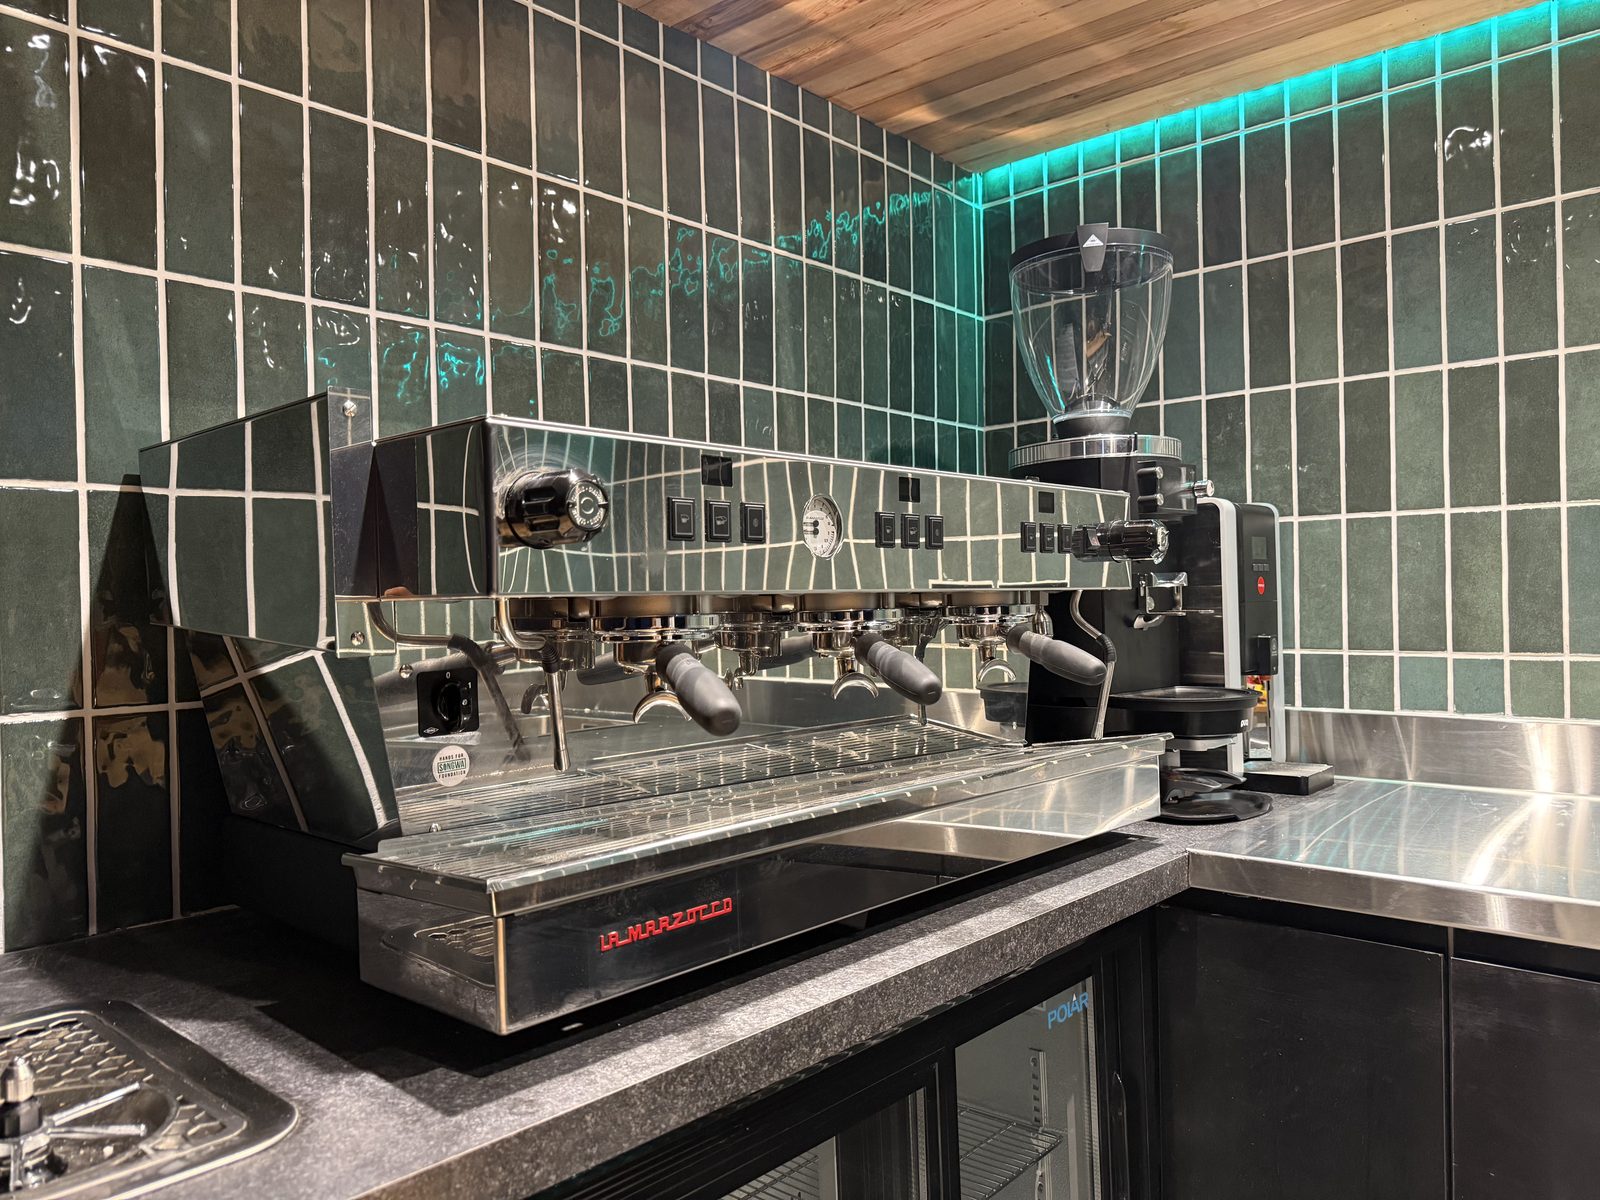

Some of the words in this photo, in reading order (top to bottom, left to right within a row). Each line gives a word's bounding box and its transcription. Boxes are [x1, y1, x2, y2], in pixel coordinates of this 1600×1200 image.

[438, 760, 465, 772] SONGWA
[438, 769, 466, 779] FOUNDATION
[600, 930, 619, 952] LA
[627, 897, 733, 942] MARZOCCO
[1047, 991, 1089, 1030] POLAR
